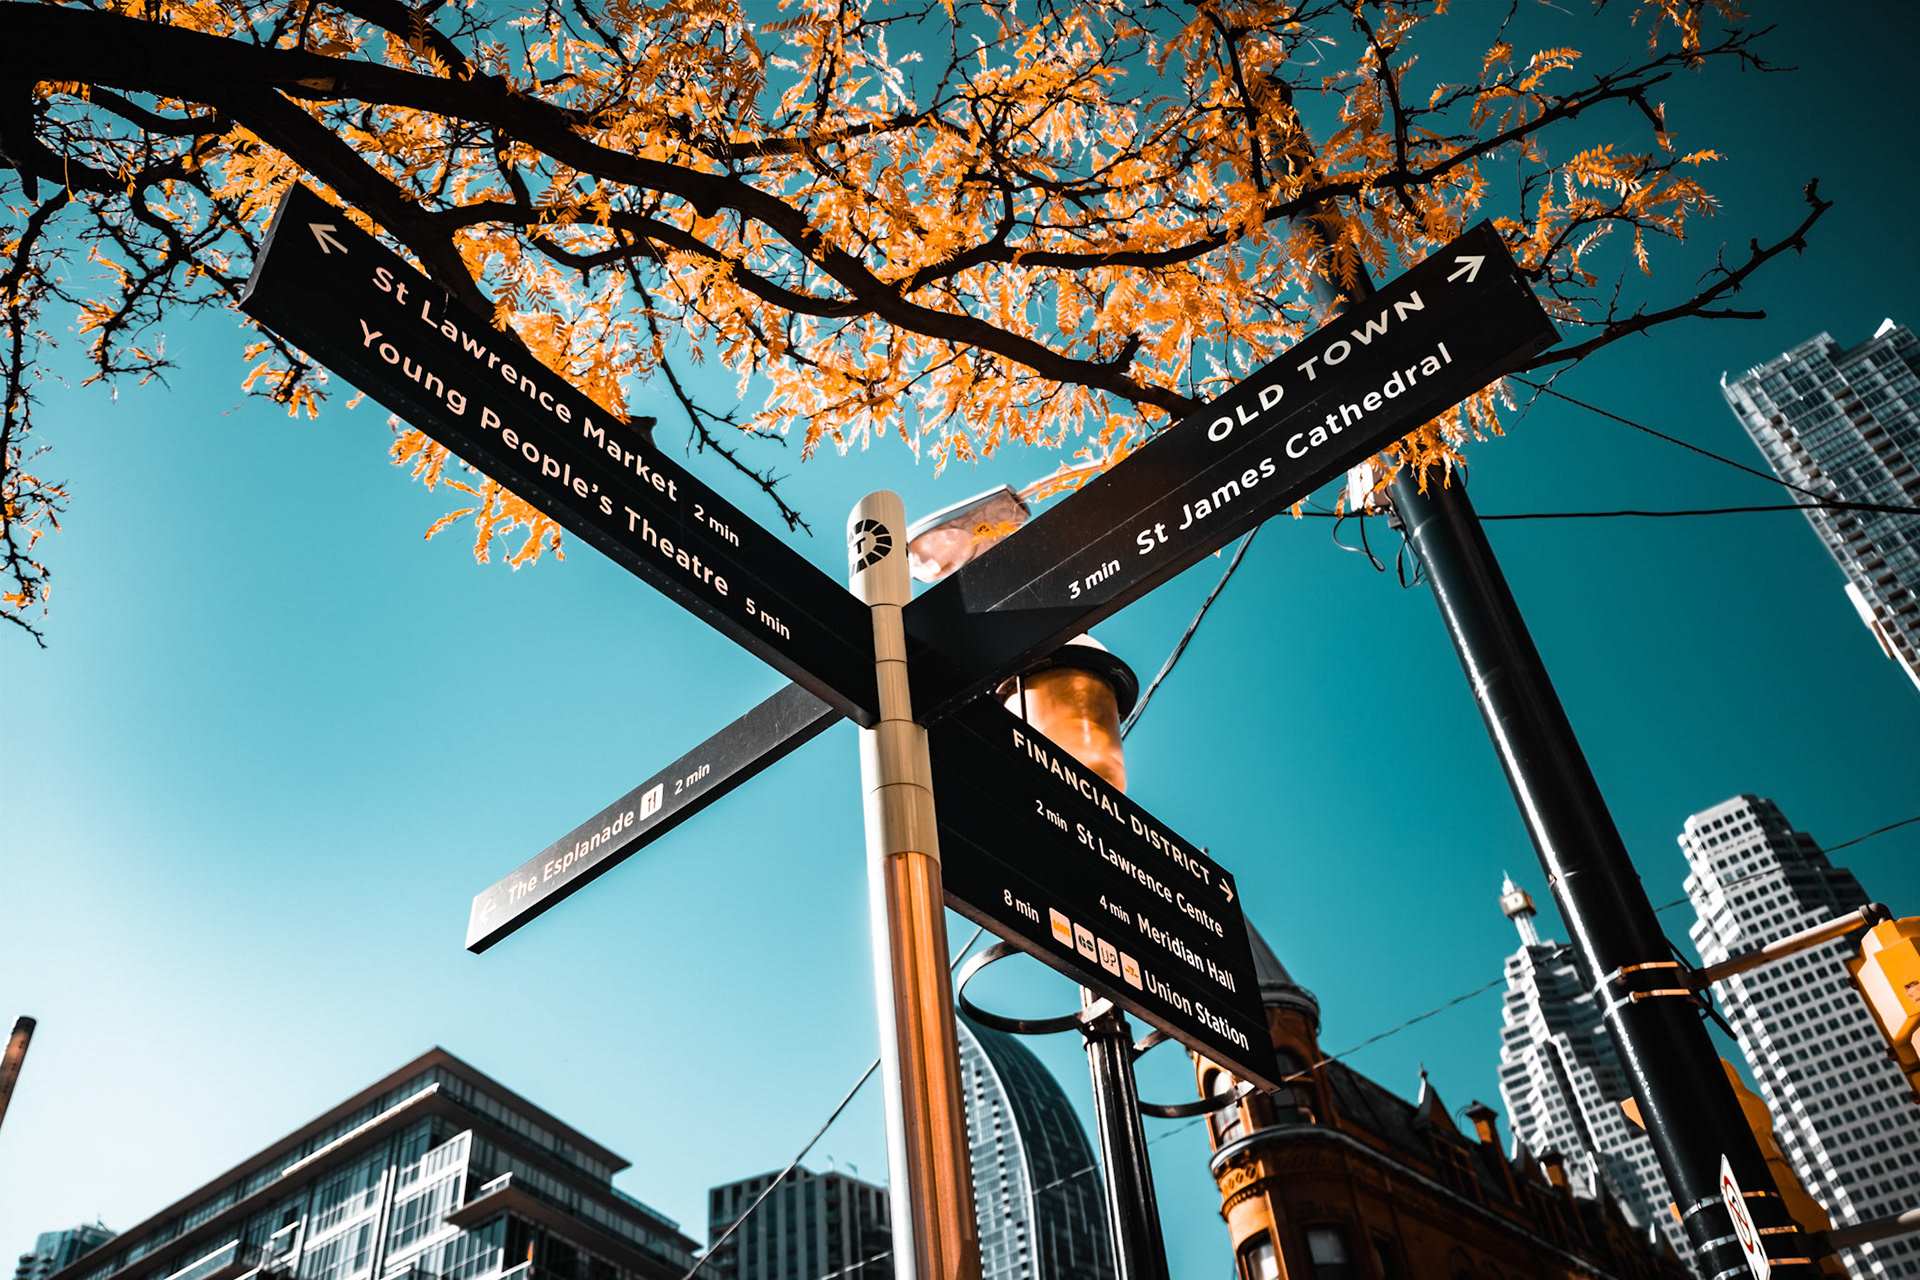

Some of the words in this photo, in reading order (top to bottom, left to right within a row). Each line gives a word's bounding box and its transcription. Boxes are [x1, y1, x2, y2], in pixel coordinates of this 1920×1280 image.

[372, 266, 409, 306] St
[421, 299, 572, 424] Lawrence
[583, 416, 678, 502] Market
[694, 503, 705, 522] 2
[709, 516, 739, 548] min
[1207, 384, 1284, 442] OLD
[1297, 290, 1425, 381] TOWN
[359, 318, 467, 416] Young
[480, 406, 613, 516] People's
[624, 505, 729, 596] Theatre
[746, 597, 756, 615] 5
[760, 610, 790, 640] min
[1068, 580, 1081, 600] 3
[1084, 559, 1121, 590] min
[1136, 522, 1169, 555] St
[1178, 457, 1276, 531] James
[1285, 341, 1453, 459] Cathedral
[508, 873, 537, 905] The
[543, 811, 634, 882] Esplanade
[675, 780, 684, 795] 2
[686, 763, 710, 787] min
[1012, 728, 1126, 825] FINANCIAL
[1129, 814, 1210, 885] DISTRICT
[1035, 799, 1045, 816] 2
[1045, 808, 1068, 832] min
[1076, 822, 1095, 851] St
[1098, 837, 1173, 904] Lawrence
[1176, 892, 1224, 938] Centre
[1003, 888, 1013, 907] 8
[1015, 898, 1040, 924] min
[1144, 969, 1193, 1017] Union
[1195, 1001, 1250, 1051] Station
[1099, 894, 1108, 910] 4
[1109, 902, 1131, 925] min
[1136, 912, 1205, 973] Meridian
[1206, 958, 1236, 993] Hall
